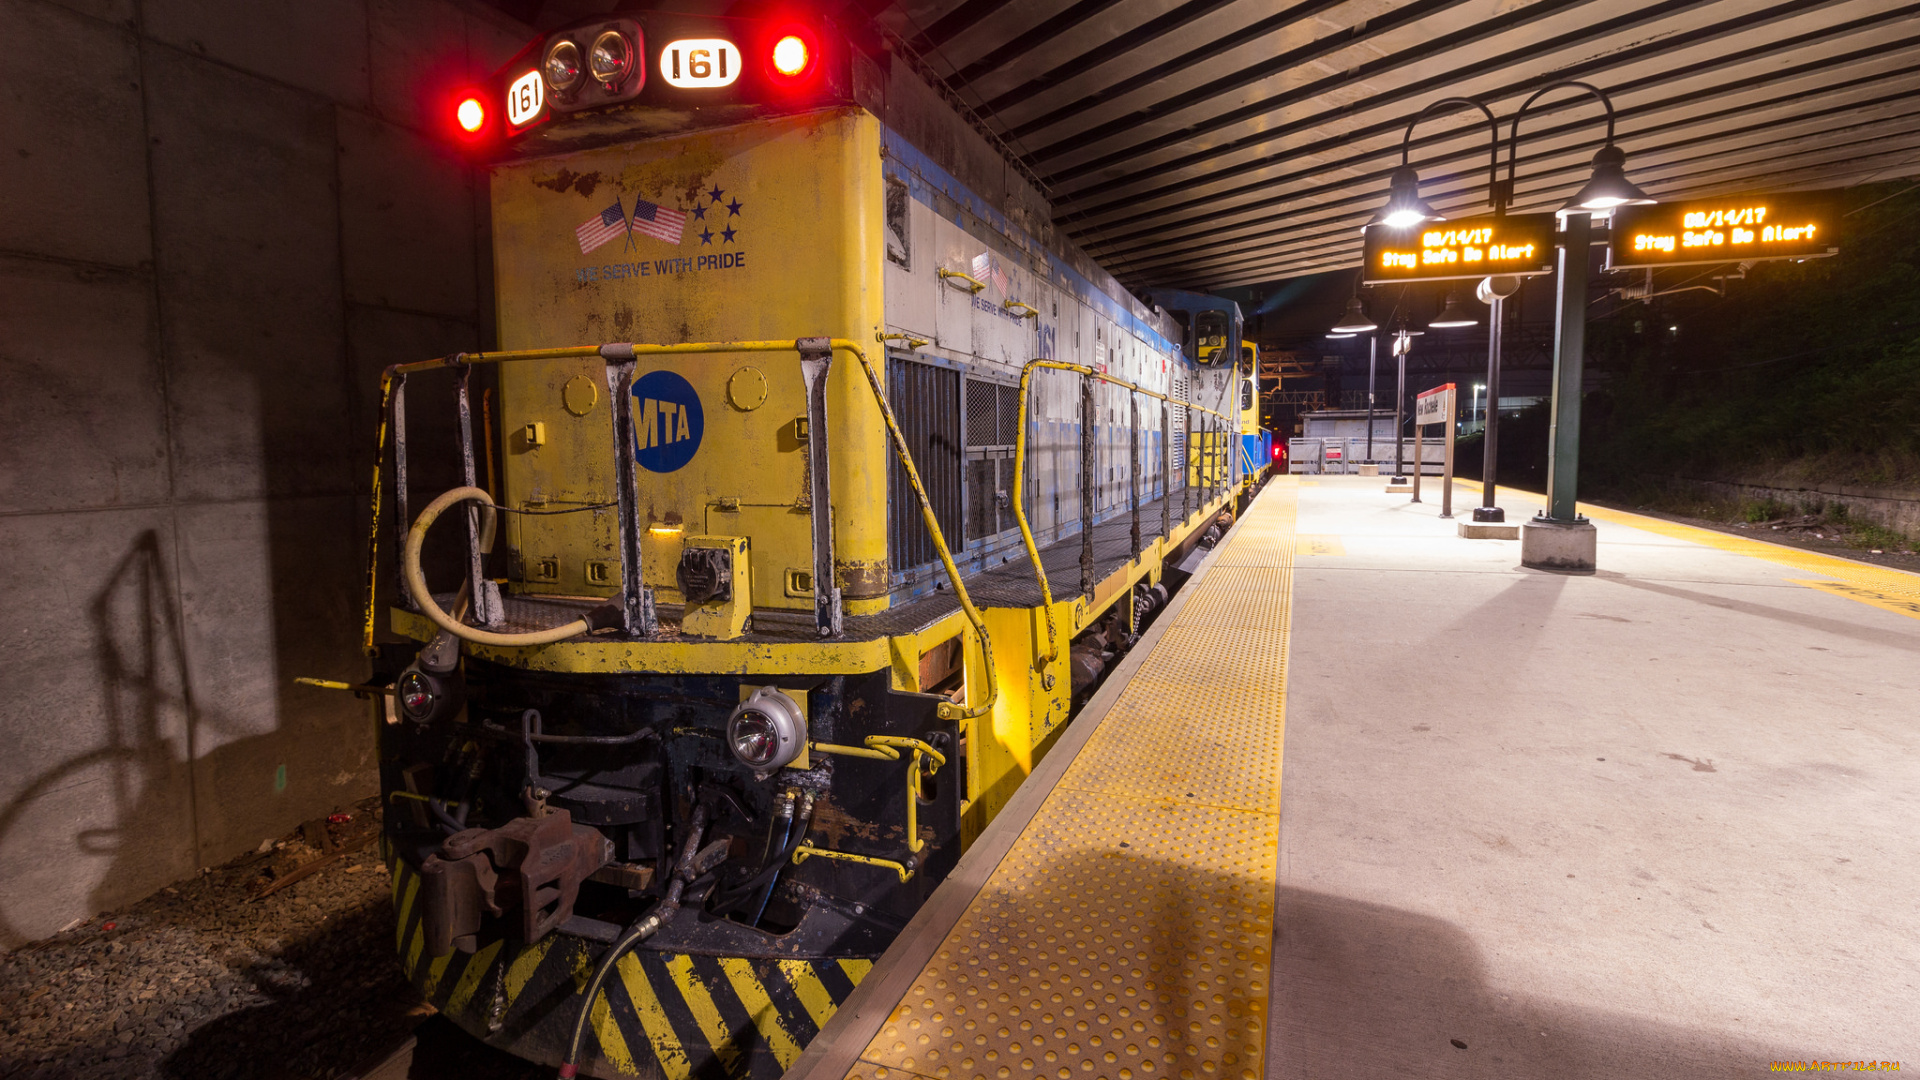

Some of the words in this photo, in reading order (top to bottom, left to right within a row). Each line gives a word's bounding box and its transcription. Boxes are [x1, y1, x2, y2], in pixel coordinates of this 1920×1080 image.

[671, 48, 728, 80] 161
[511, 78, 540, 119] 161
[1683, 207, 1767, 228] 08/14/17
[1422, 228, 1493, 247] 08/14/17
[1634, 234, 1676, 252] Stay
[1682, 230, 1724, 248] Safe
[1731, 227, 1755, 244] Be
[1761, 223, 1816, 242] Alert
[576, 267, 599, 283] WE
[602, 261, 651, 281] SERVE
[654, 257, 693, 275] WITH
[697, 251, 746, 271] PRIDE
[1382, 252, 1417, 269] Stay
[1422, 248, 1458, 264] Safe
[1463, 246, 1483, 262] Be
[1488, 244, 1535, 261] Alert
[980, 298, 997, 316] SERVE
[632, 394, 691, 450] MTA
